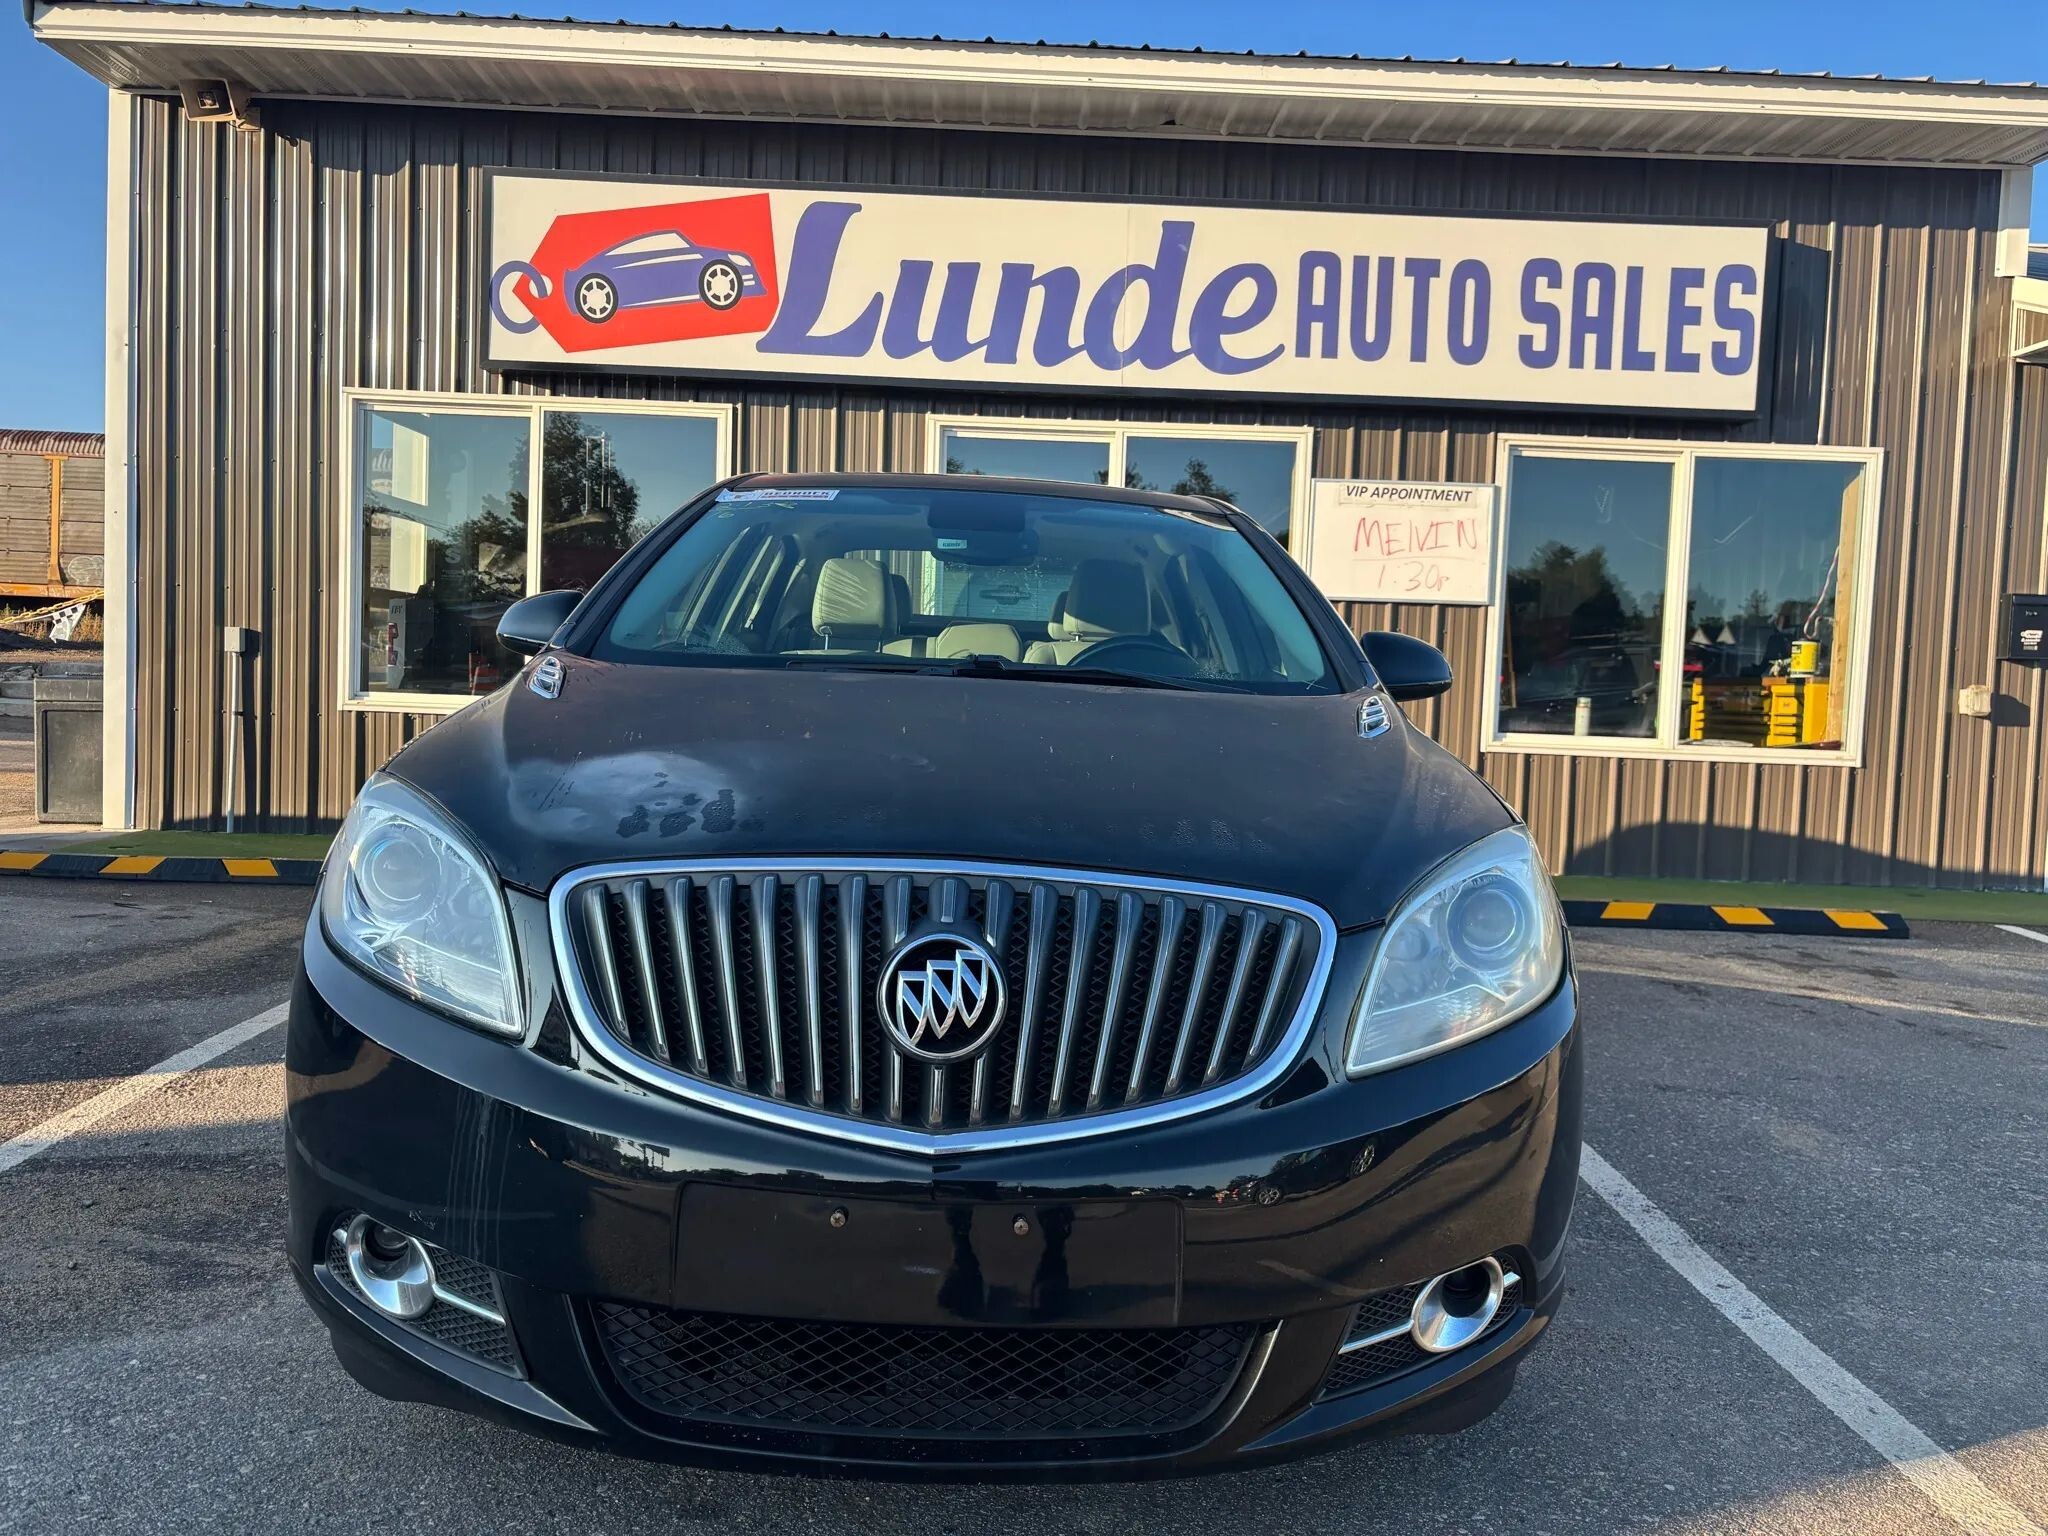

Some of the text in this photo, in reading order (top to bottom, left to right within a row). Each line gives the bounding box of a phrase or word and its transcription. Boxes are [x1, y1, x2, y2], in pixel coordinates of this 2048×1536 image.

[756, 201, 1758, 376] Lunde AUTO SALES
[1346, 485, 1473, 502] VIP APPOINTMENT
